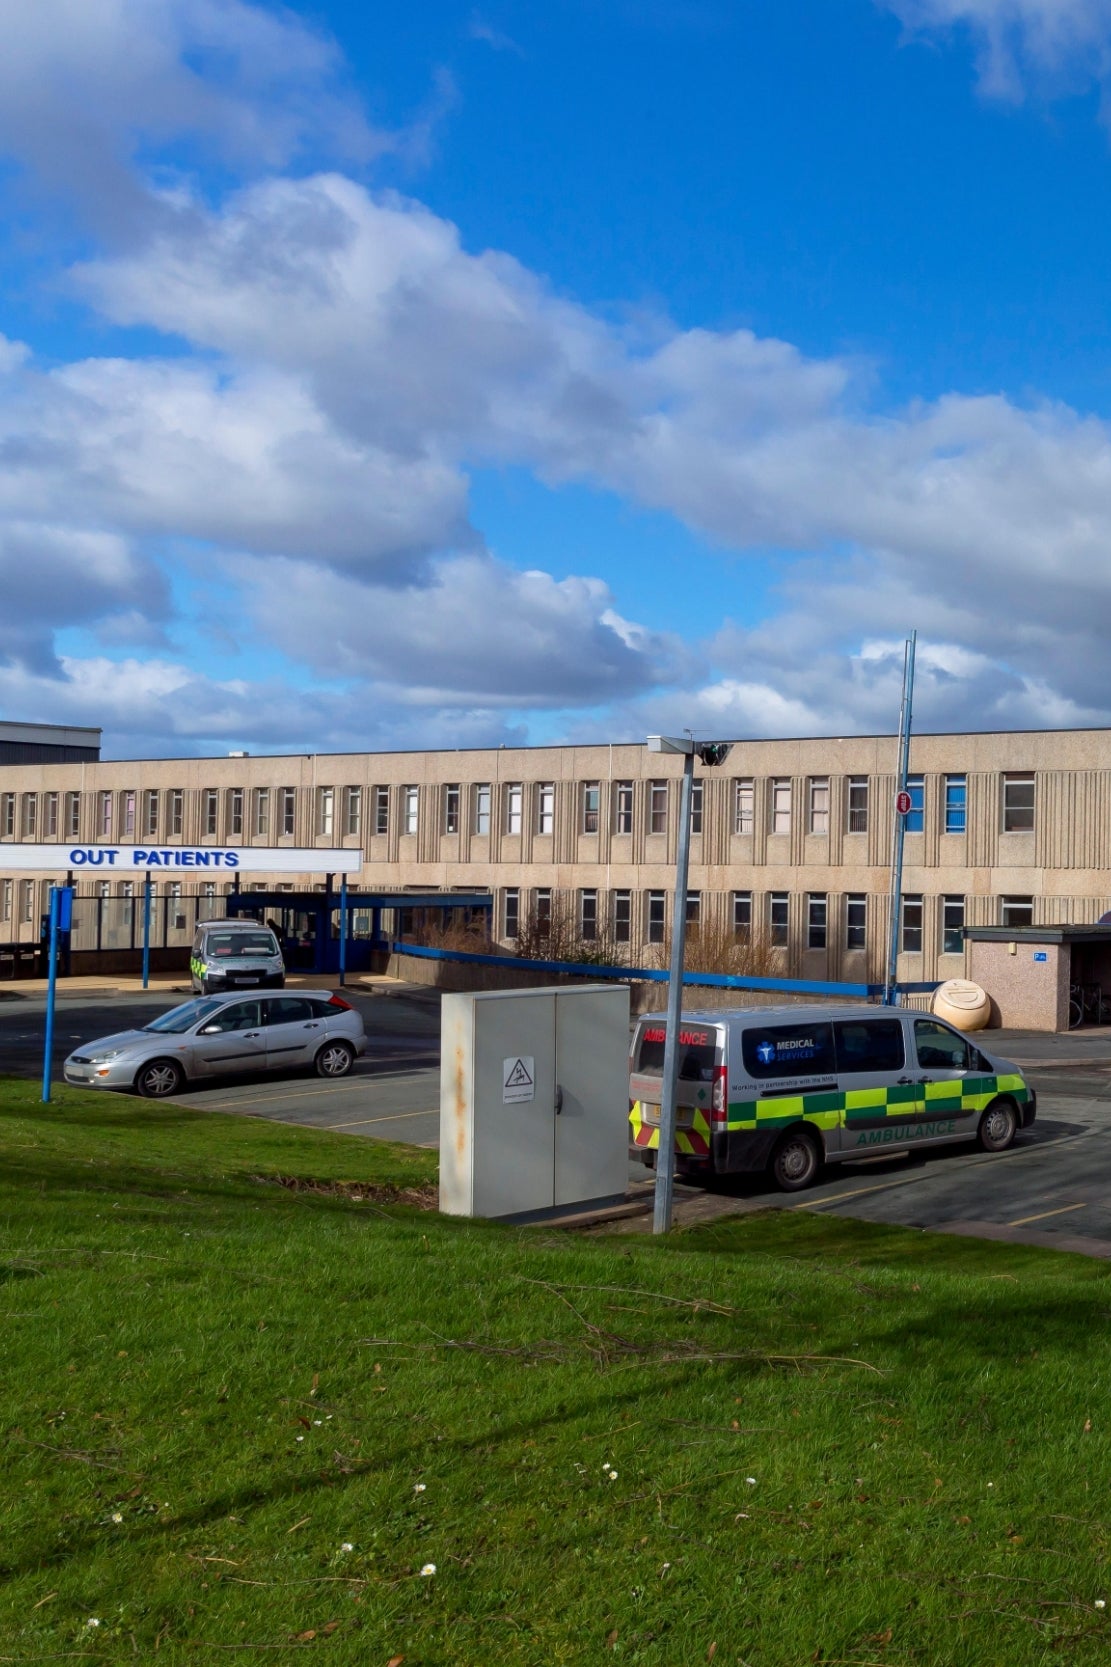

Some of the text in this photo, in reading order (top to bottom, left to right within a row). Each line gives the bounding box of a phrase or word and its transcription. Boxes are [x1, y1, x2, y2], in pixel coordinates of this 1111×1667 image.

[69, 849, 240, 867] OUT PATIENTS
[644, 1029, 708, 1045] AMBANCE
[776, 1039, 815, 1050] MEDICAL
[777, 1050, 814, 1061] SERVICES
[731, 1083, 758, 1092] Working
[765, 1080, 798, 1089] partnership
[857, 1119, 956, 1144] AMBULANCE
